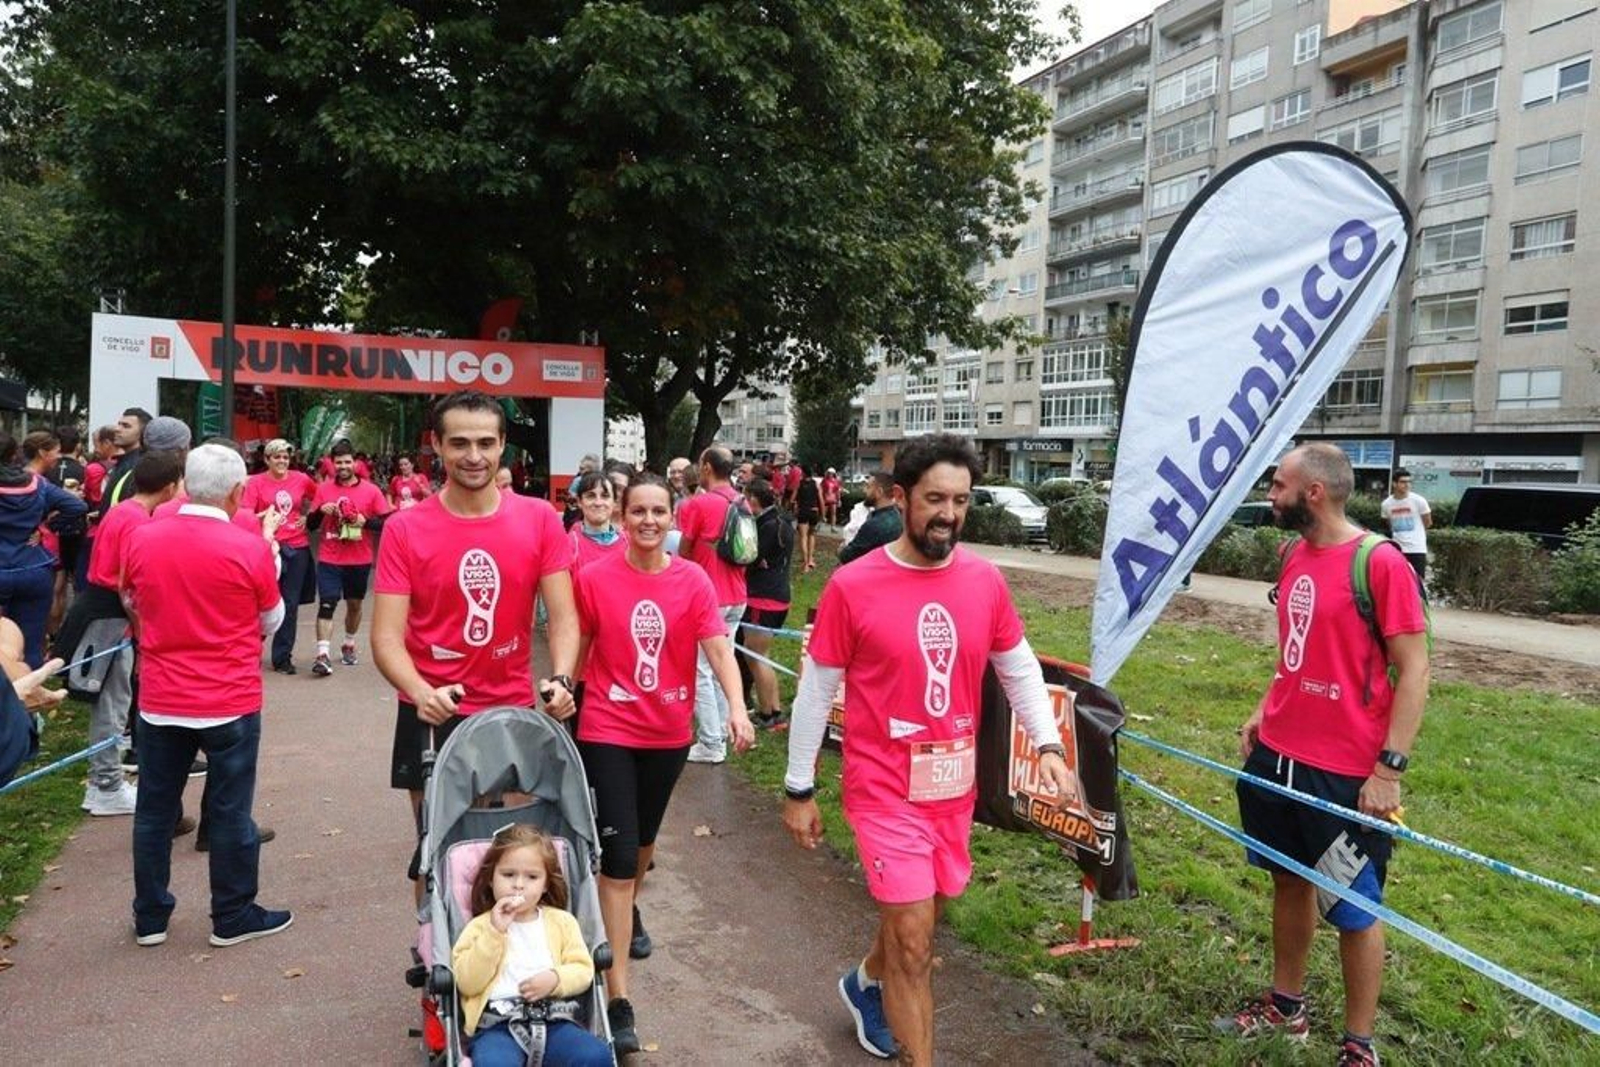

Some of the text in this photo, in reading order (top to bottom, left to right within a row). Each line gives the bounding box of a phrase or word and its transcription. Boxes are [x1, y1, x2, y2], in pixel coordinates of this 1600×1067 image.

[102, 336, 145, 346] CONCELLO
[1111, 218, 1378, 620] Atlántico
[1022, 441, 1062, 451] farmacia
[932, 757, 963, 783] 5211
